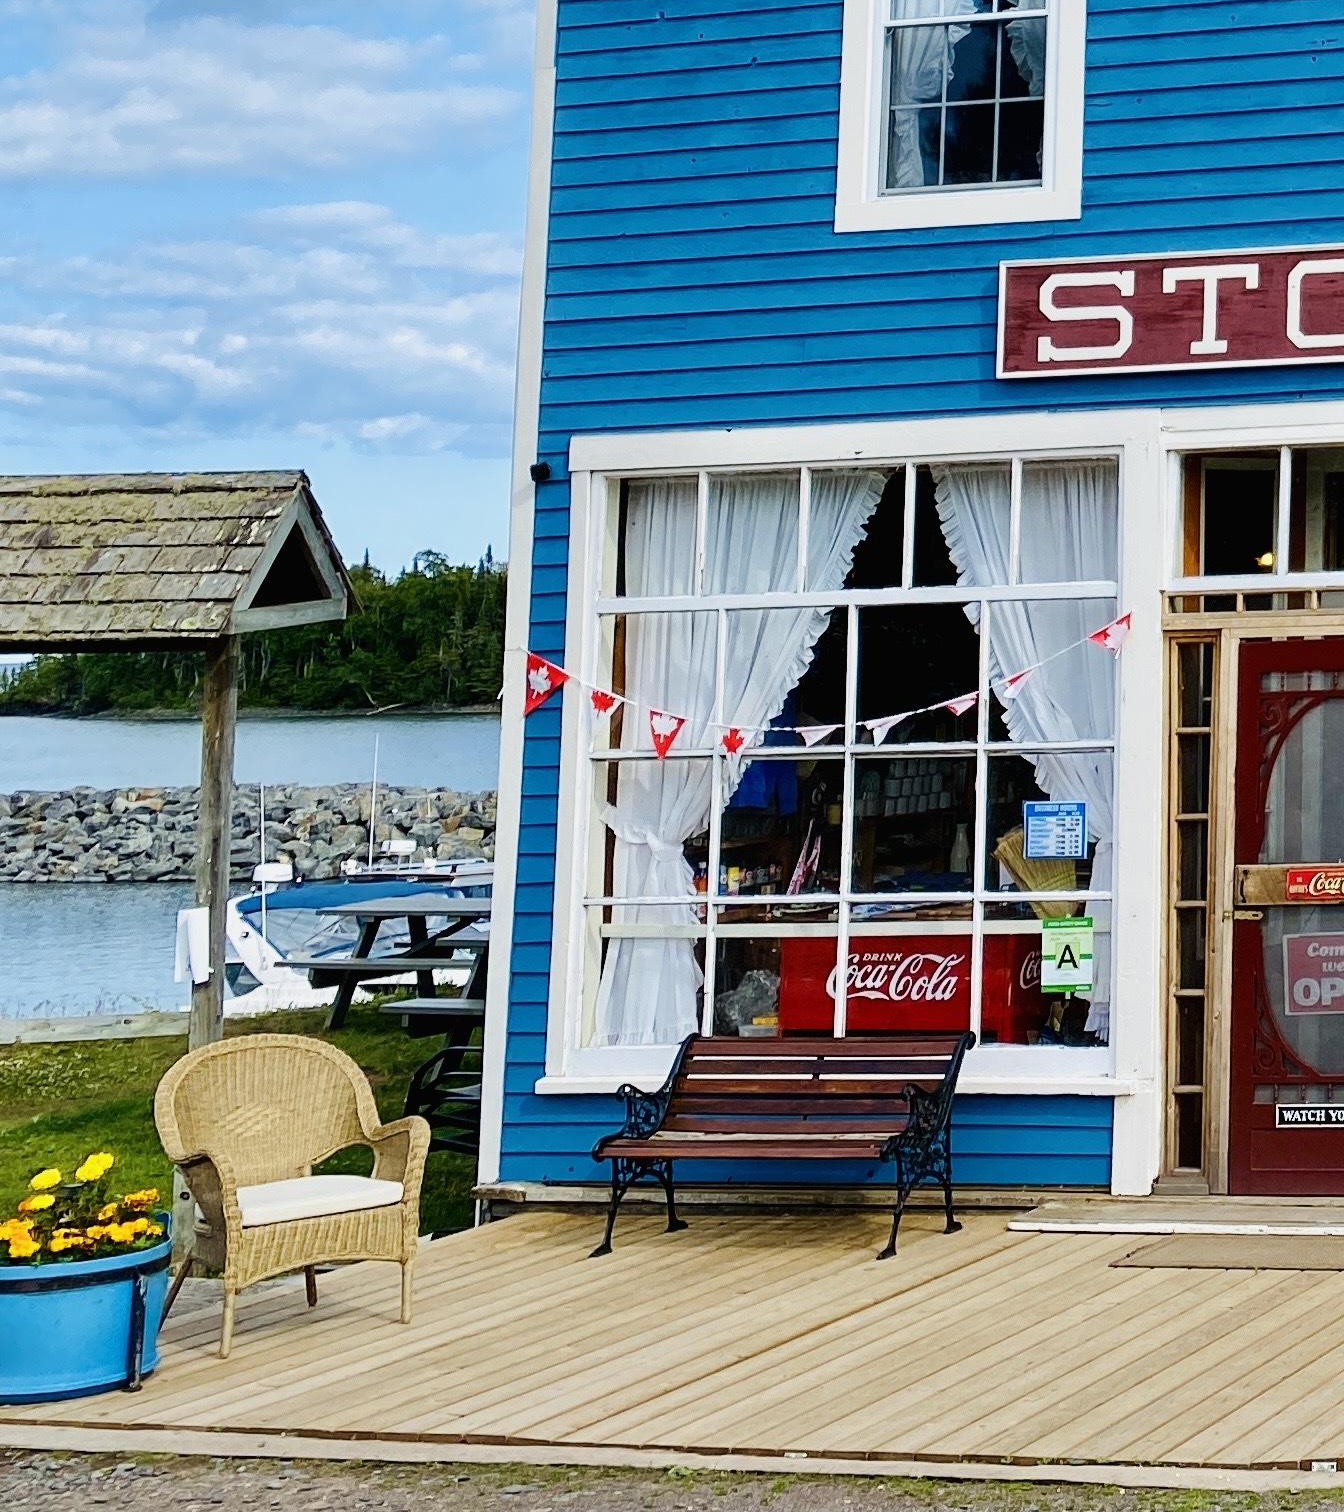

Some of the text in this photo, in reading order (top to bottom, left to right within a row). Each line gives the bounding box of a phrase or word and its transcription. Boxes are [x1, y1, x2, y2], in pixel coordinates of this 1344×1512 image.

[862, 952, 904, 962] DRINK
[1056, 944, 1079, 969] A
[825, 953, 965, 1001] Coca-Cola
[1282, 1109, 1326, 1122] WATCH
